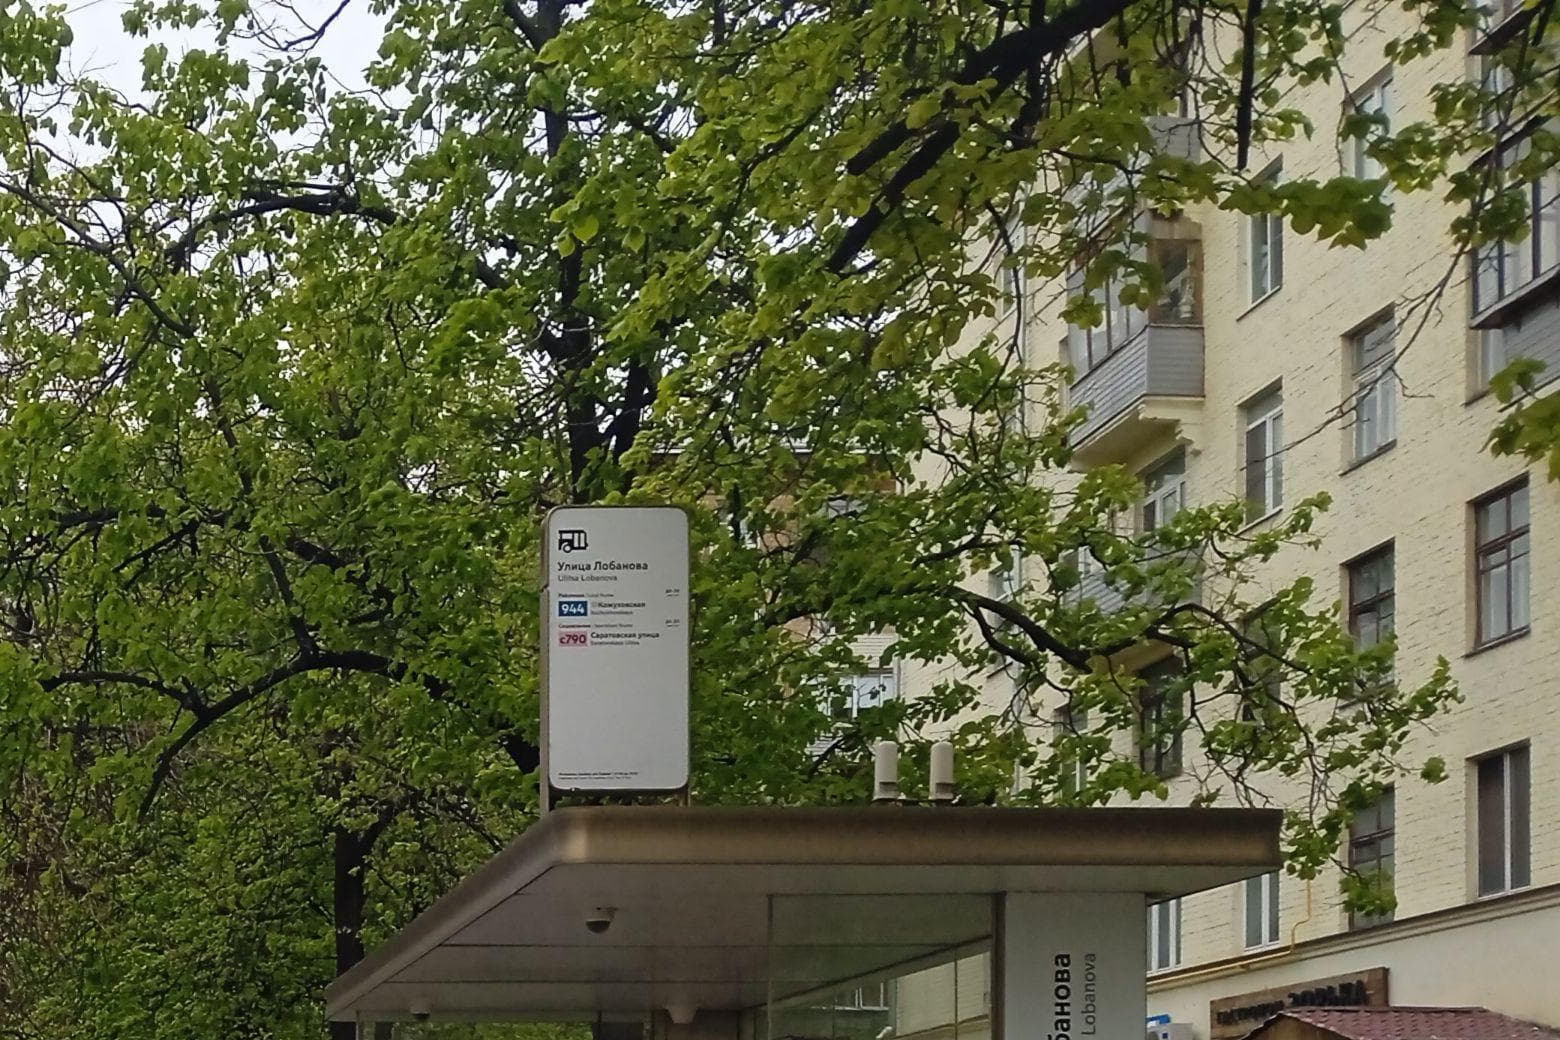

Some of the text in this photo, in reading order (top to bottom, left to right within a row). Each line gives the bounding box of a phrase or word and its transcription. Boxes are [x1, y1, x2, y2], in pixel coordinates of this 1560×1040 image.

[557, 560, 649, 572] Улица Лобанова
[561, 603, 585, 614] 944
[1081, 953, 1096, 1035] Lobanova
